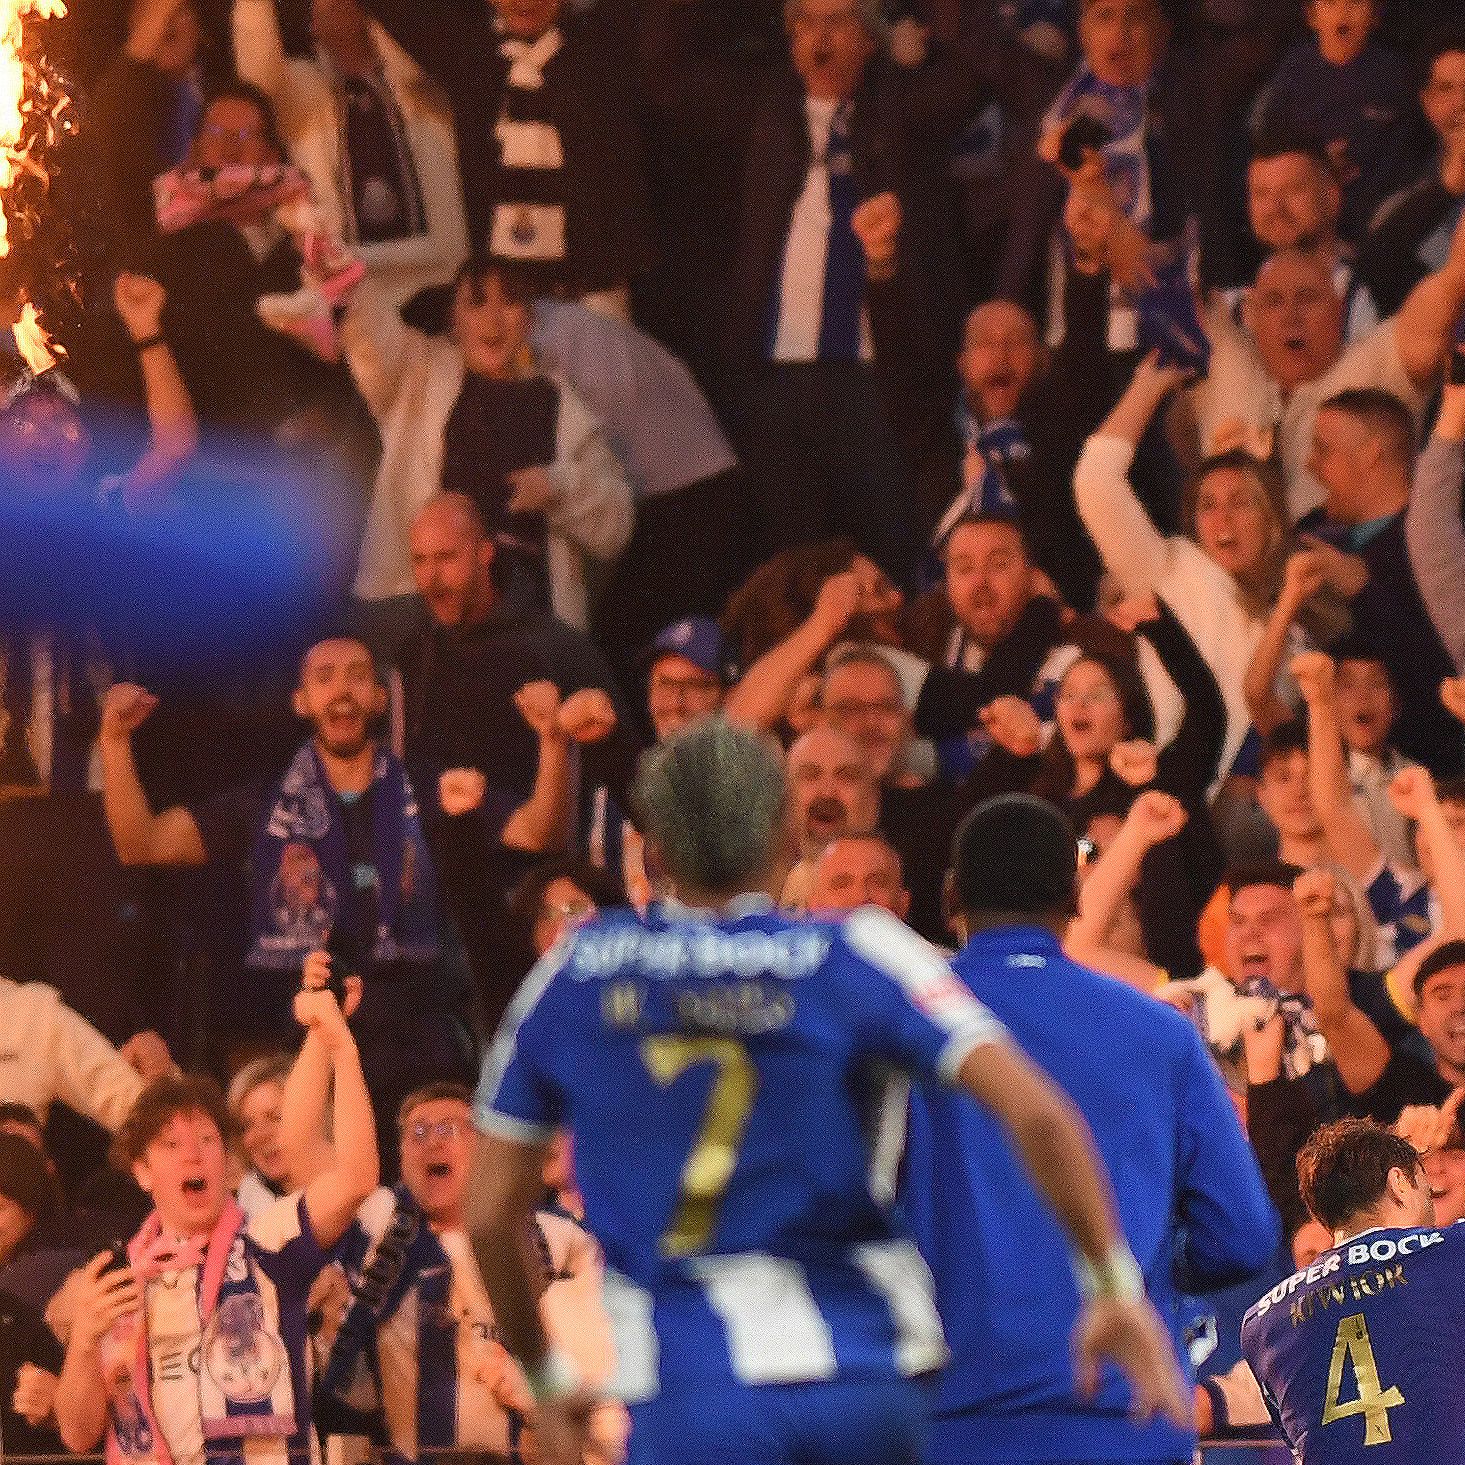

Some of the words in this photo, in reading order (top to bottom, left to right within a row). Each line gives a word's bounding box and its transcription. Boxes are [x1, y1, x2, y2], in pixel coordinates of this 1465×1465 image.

[640, 1034, 760, 1258] 7
[1257, 1253, 1341, 1317] SUPER
[1348, 1231, 1445, 1266] BOCK
[1322, 1312, 1406, 1446] 4
